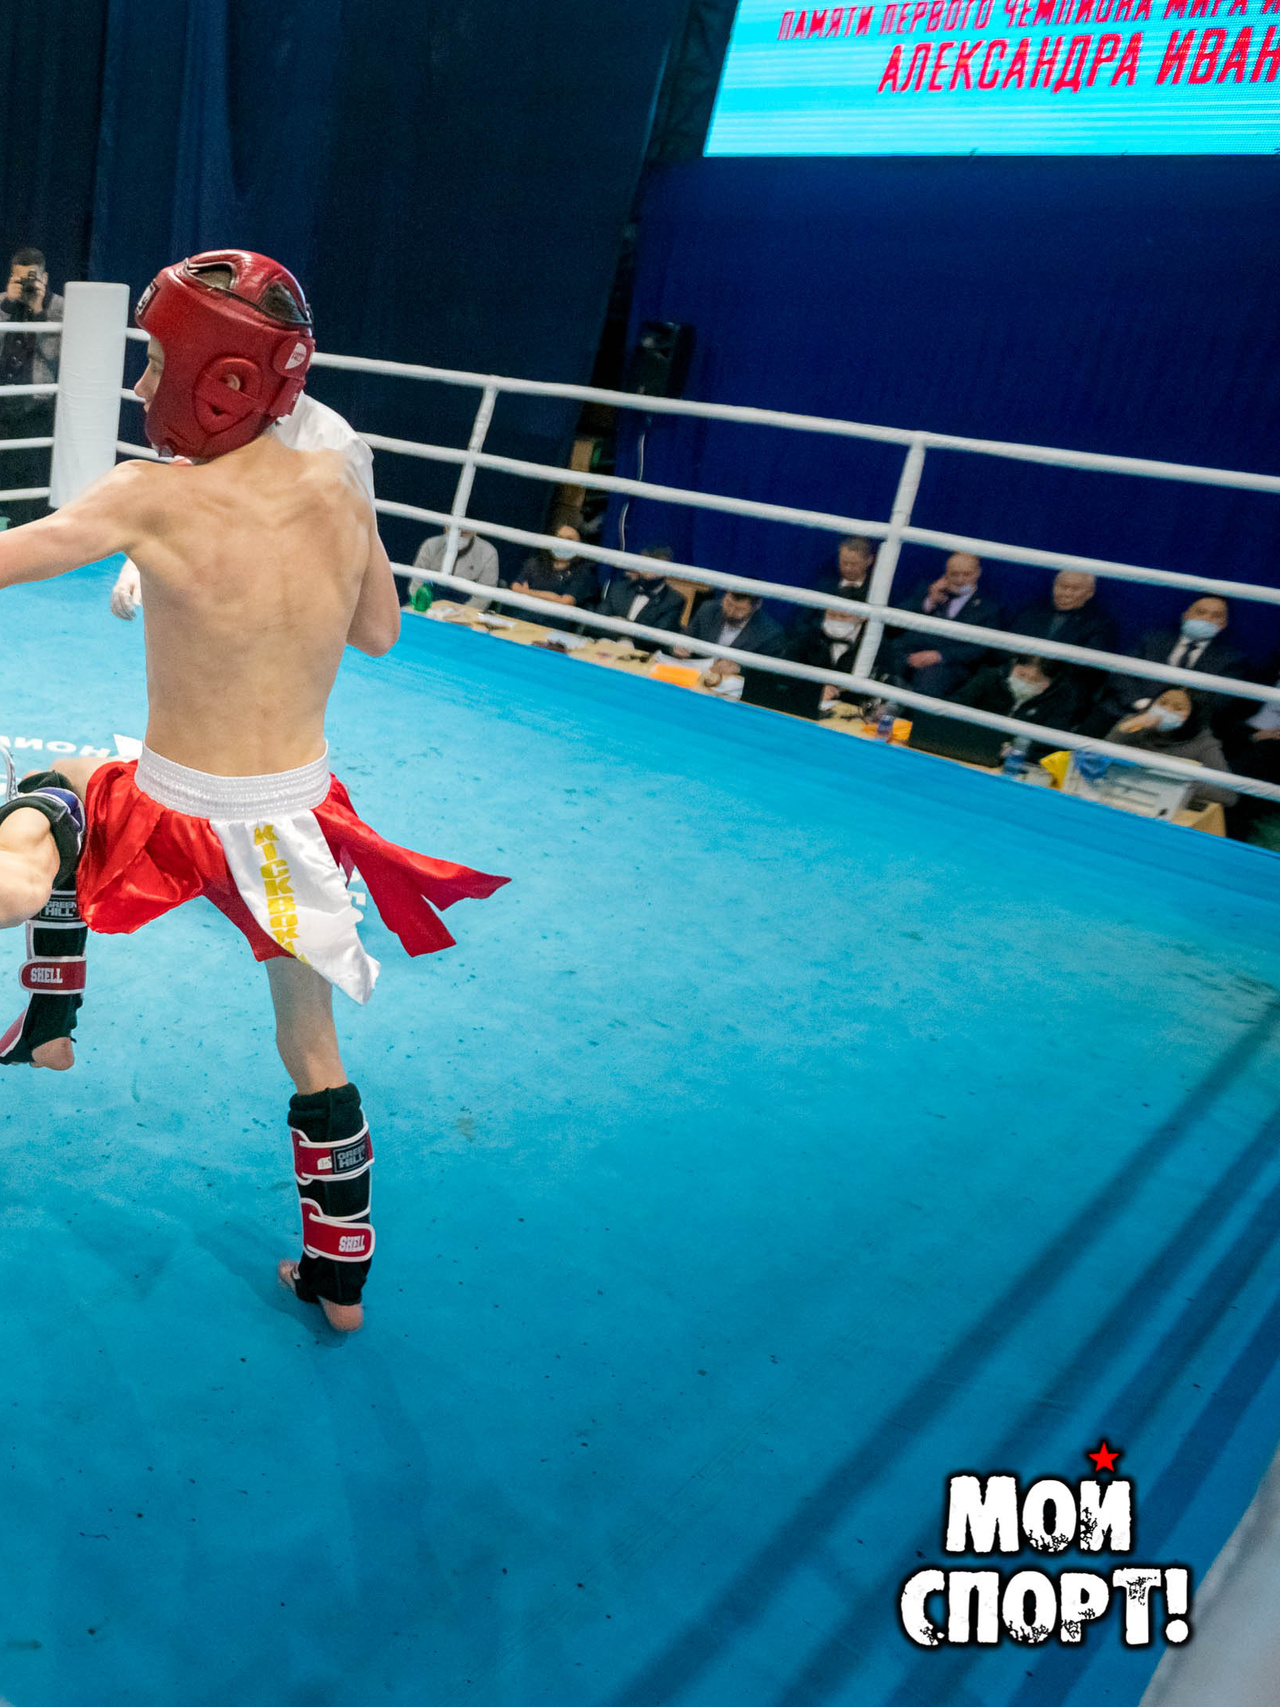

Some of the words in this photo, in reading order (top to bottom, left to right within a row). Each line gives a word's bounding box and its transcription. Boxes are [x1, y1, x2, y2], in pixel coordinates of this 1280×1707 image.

[778, 6, 874, 40] ПАМЯТИ
[878, 0, 995, 35] ПЕРВОГО
[1004, 0, 1153, 27] ЧЕМПИОНА
[877, 32, 1143, 93] АЛЕКСАНДРА
[1155, 25, 1280, 85] ИВАН
[45, 907, 74, 917] HILL
[30, 967, 63, 984] SHELL
[338, 1153, 365, 1169] HILL
[338, 1234, 366, 1252] SHELL
